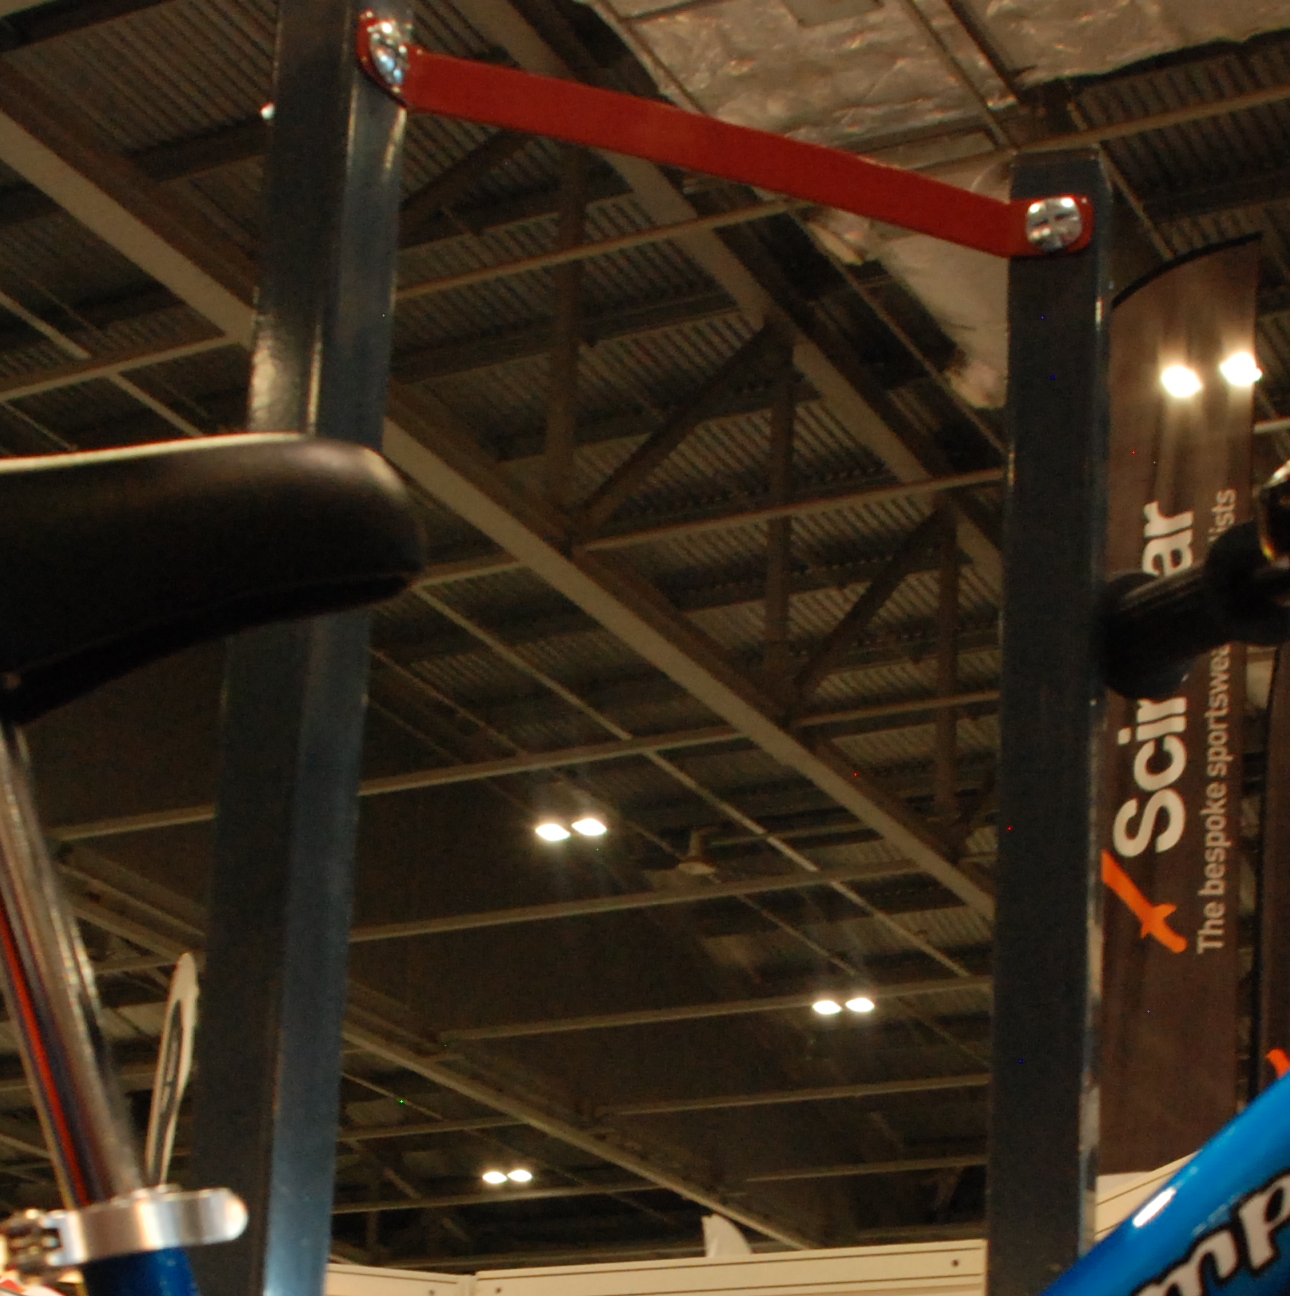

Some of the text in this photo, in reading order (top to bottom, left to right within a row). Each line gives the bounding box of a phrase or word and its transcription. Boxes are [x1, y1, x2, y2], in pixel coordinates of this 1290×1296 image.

[1112, 501, 1195, 858] Sciar
[1197, 642, 1233, 955] The bespoke sportswea
